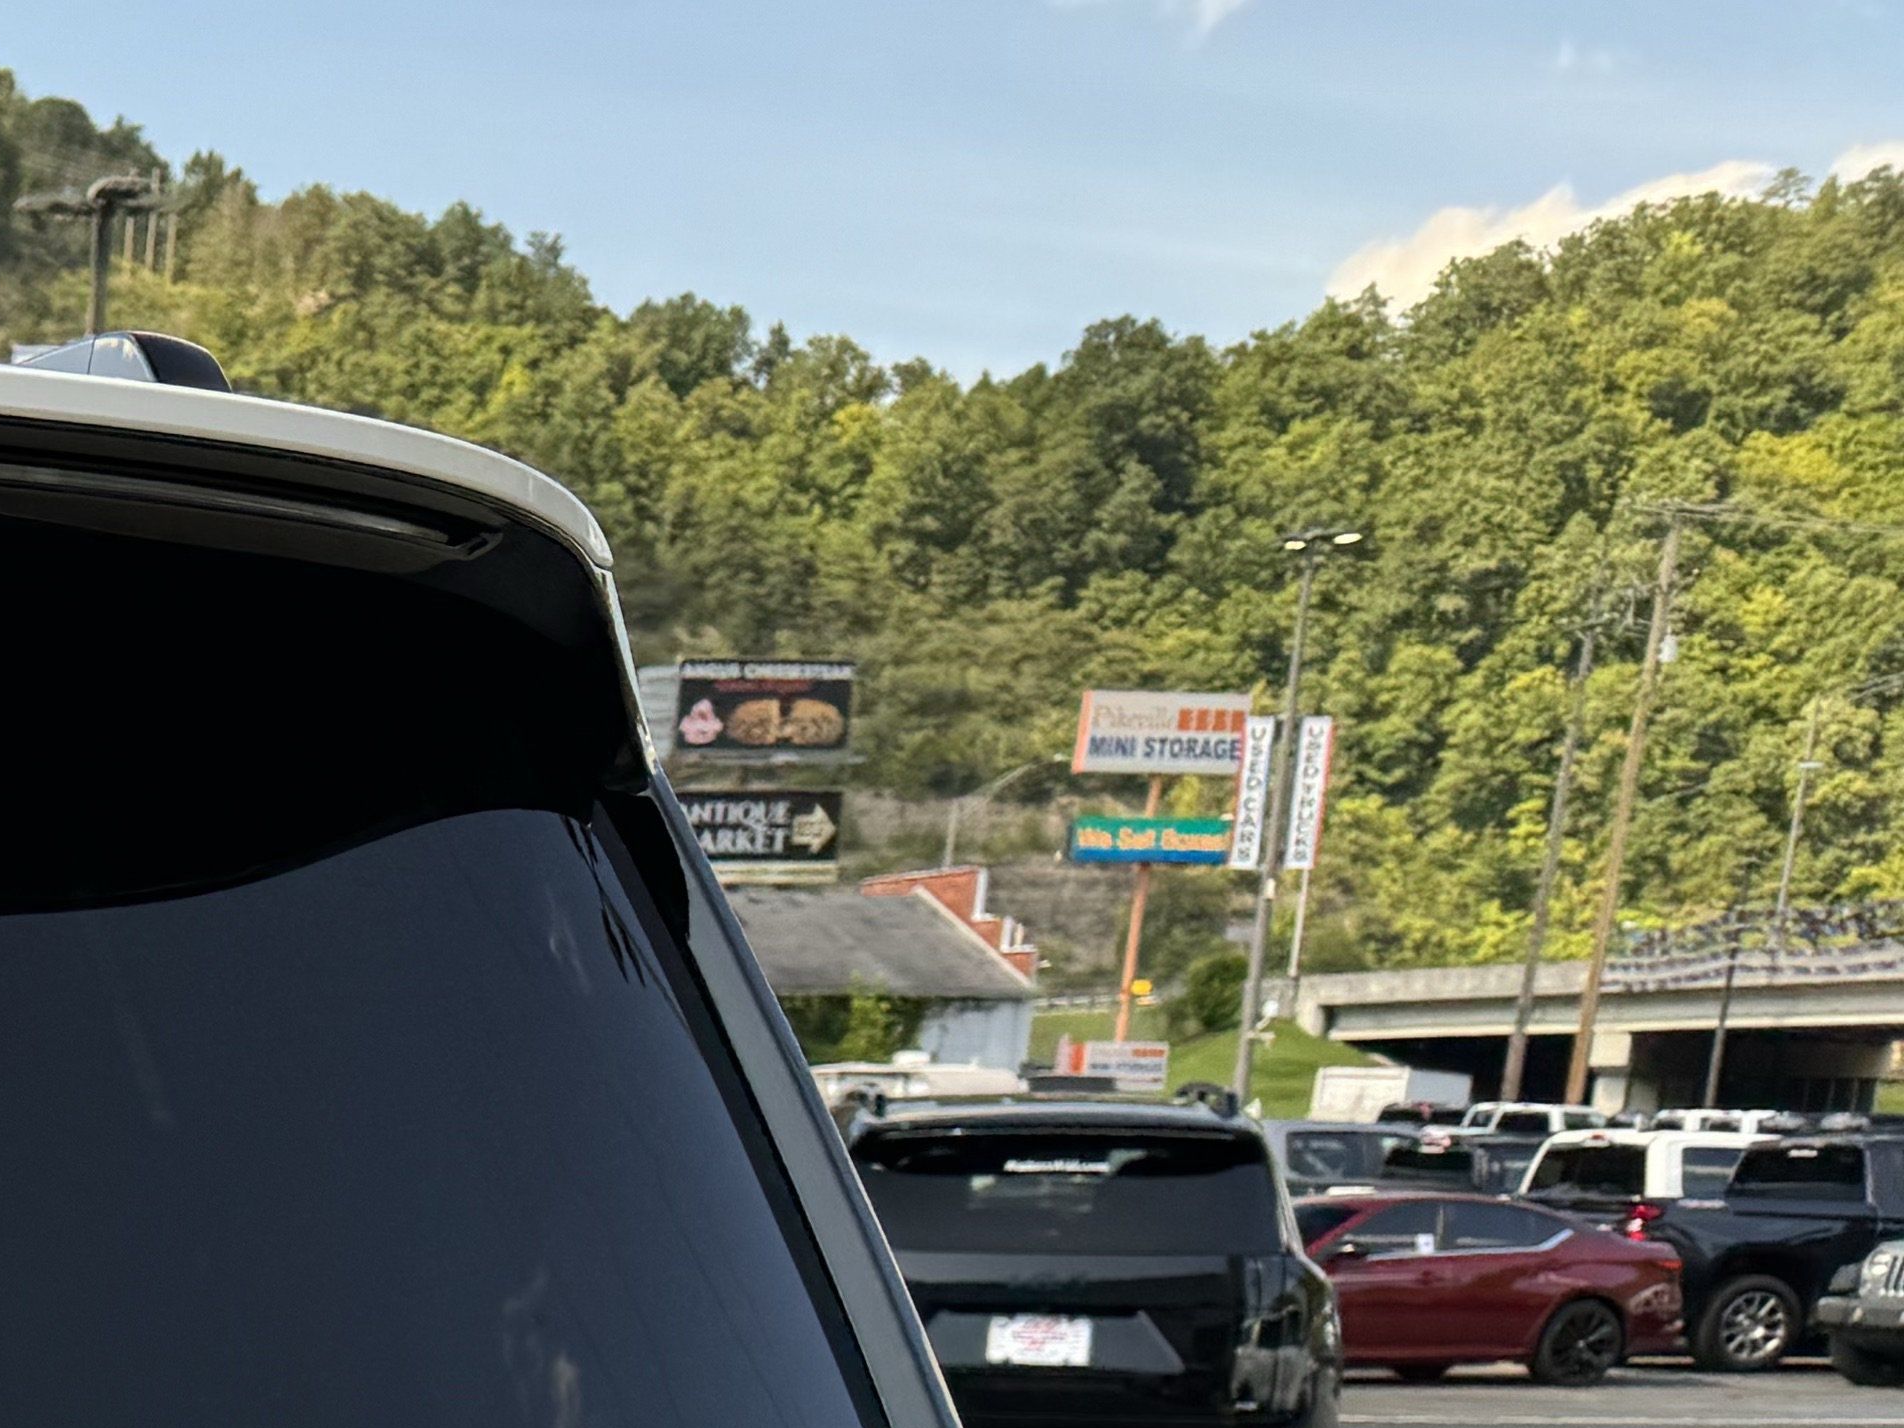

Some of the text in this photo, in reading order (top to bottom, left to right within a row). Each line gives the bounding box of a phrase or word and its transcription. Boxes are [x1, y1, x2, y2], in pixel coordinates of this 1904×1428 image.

[1088, 735, 1242, 761] MINI STORAGE
[696, 828, 788, 854] ARKET
